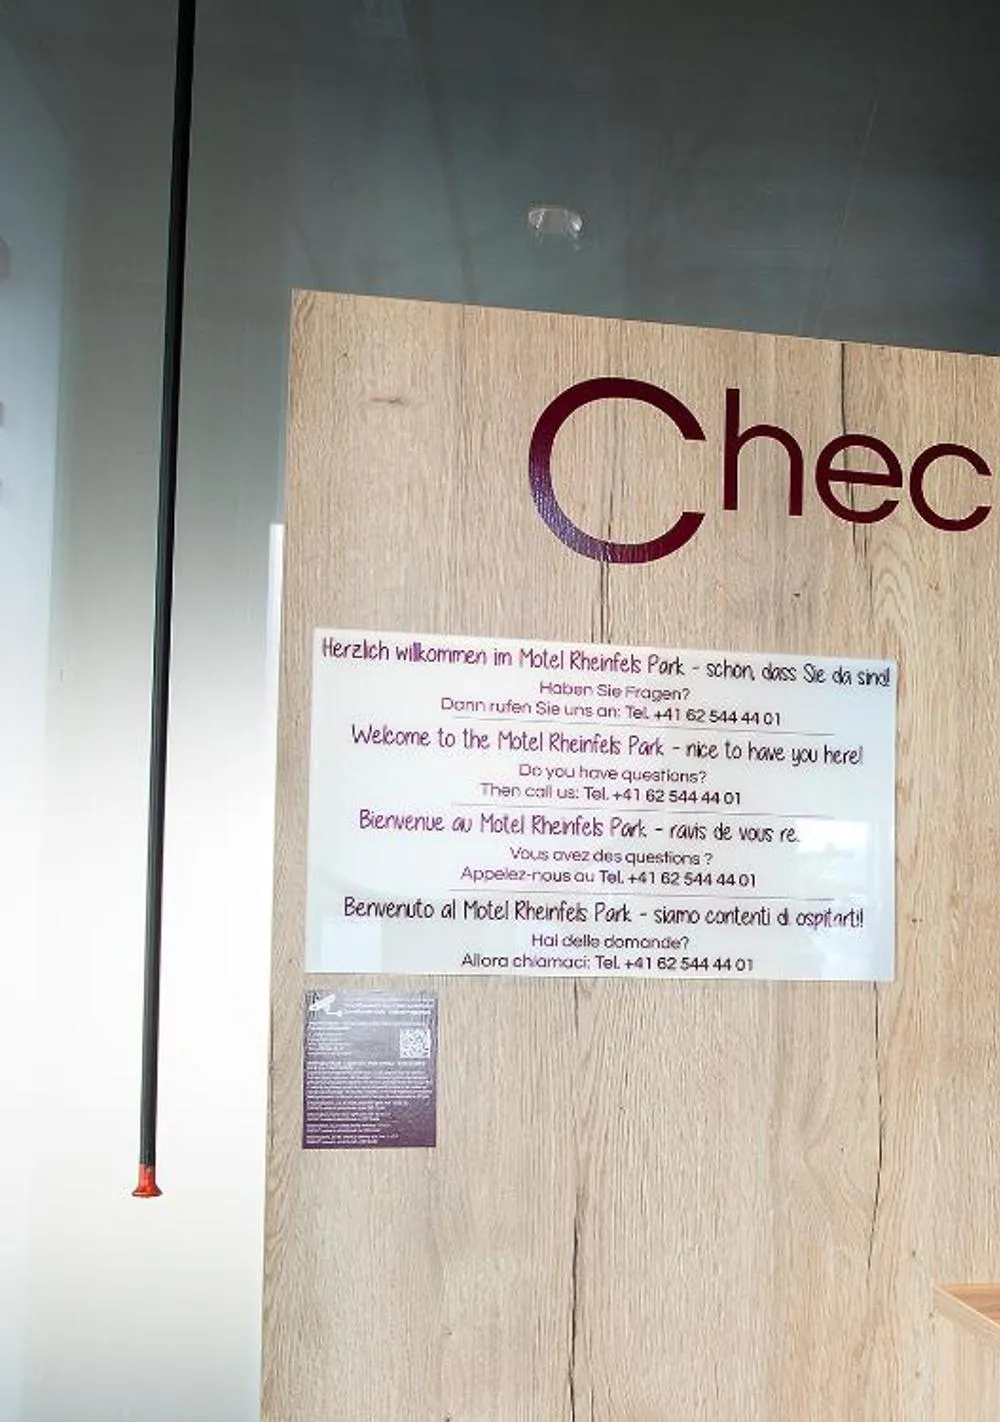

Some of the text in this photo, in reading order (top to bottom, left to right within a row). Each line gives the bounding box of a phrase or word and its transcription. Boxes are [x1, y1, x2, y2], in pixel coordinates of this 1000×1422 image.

[322, 637, 389, 660] Herzlich
[396, 642, 487, 665] willkommen
[494, 648, 512, 666] im
[520, 647, 564, 670] Motel
[570, 650, 641, 674] Rheinfels
[648, 655, 685, 676] Park
[762, 661, 797, 683] dass
[804, 663, 827, 683] Sie
[832, 666, 851, 685] da
[857, 667, 891, 688] sind!
[540, 681, 691, 701] Haben Sie Fragen?
[441, 697, 781, 726] Dann rufen Sie uns an: Tel. +41 62 544 44 01
[352, 724, 431, 747] Welcome
[438, 727, 455, 748] to
[463, 729, 490, 749] the
[498, 731, 543, 751] Motel
[549, 733, 620, 755] Rheinfels
[629, 735, 664, 756] Park
[686, 740, 719, 759] nice
[726, 742, 741, 759] to
[748, 741, 785, 761] have
[792, 747, 818, 766] you
[823, 745, 864, 765] here!
[519, 764, 707, 783] Do you have questions?
[481, 782, 741, 805] Then call us: Tel. +41 62 544 44 01
[359, 809, 444, 831] Bienvenue
[452, 817, 473, 833] au
[481, 813, 524, 835] Motel
[532, 815, 603, 837] Rheinfels
[610, 817, 647, 838] Park
[670, 822, 706, 840] ravis
[714, 822, 732, 841] de
[739, 825, 773, 842] vous
[510, 847, 549, 861] Vous
[553, 849, 589, 862] avez
[593, 849, 622, 862] des
[625, 852, 700, 866] questions
[461, 866, 756, 887] Appelez-nous au Tel. +41 62 544 44 01
[344, 896, 434, 920] Benvenuto
[441, 899, 456, 920] al
[464, 901, 508, 921] Motel
[515, 901, 587, 923] Rheinfels
[594, 902, 632, 923] Park
[654, 904, 700, 924] siamo
[705, 905, 771, 926] contenti
[532, 933, 690, 949] Hai delle domande?
[462, 954, 753, 972] Allora chiamaci: Tel. +41 62 544 44 01
